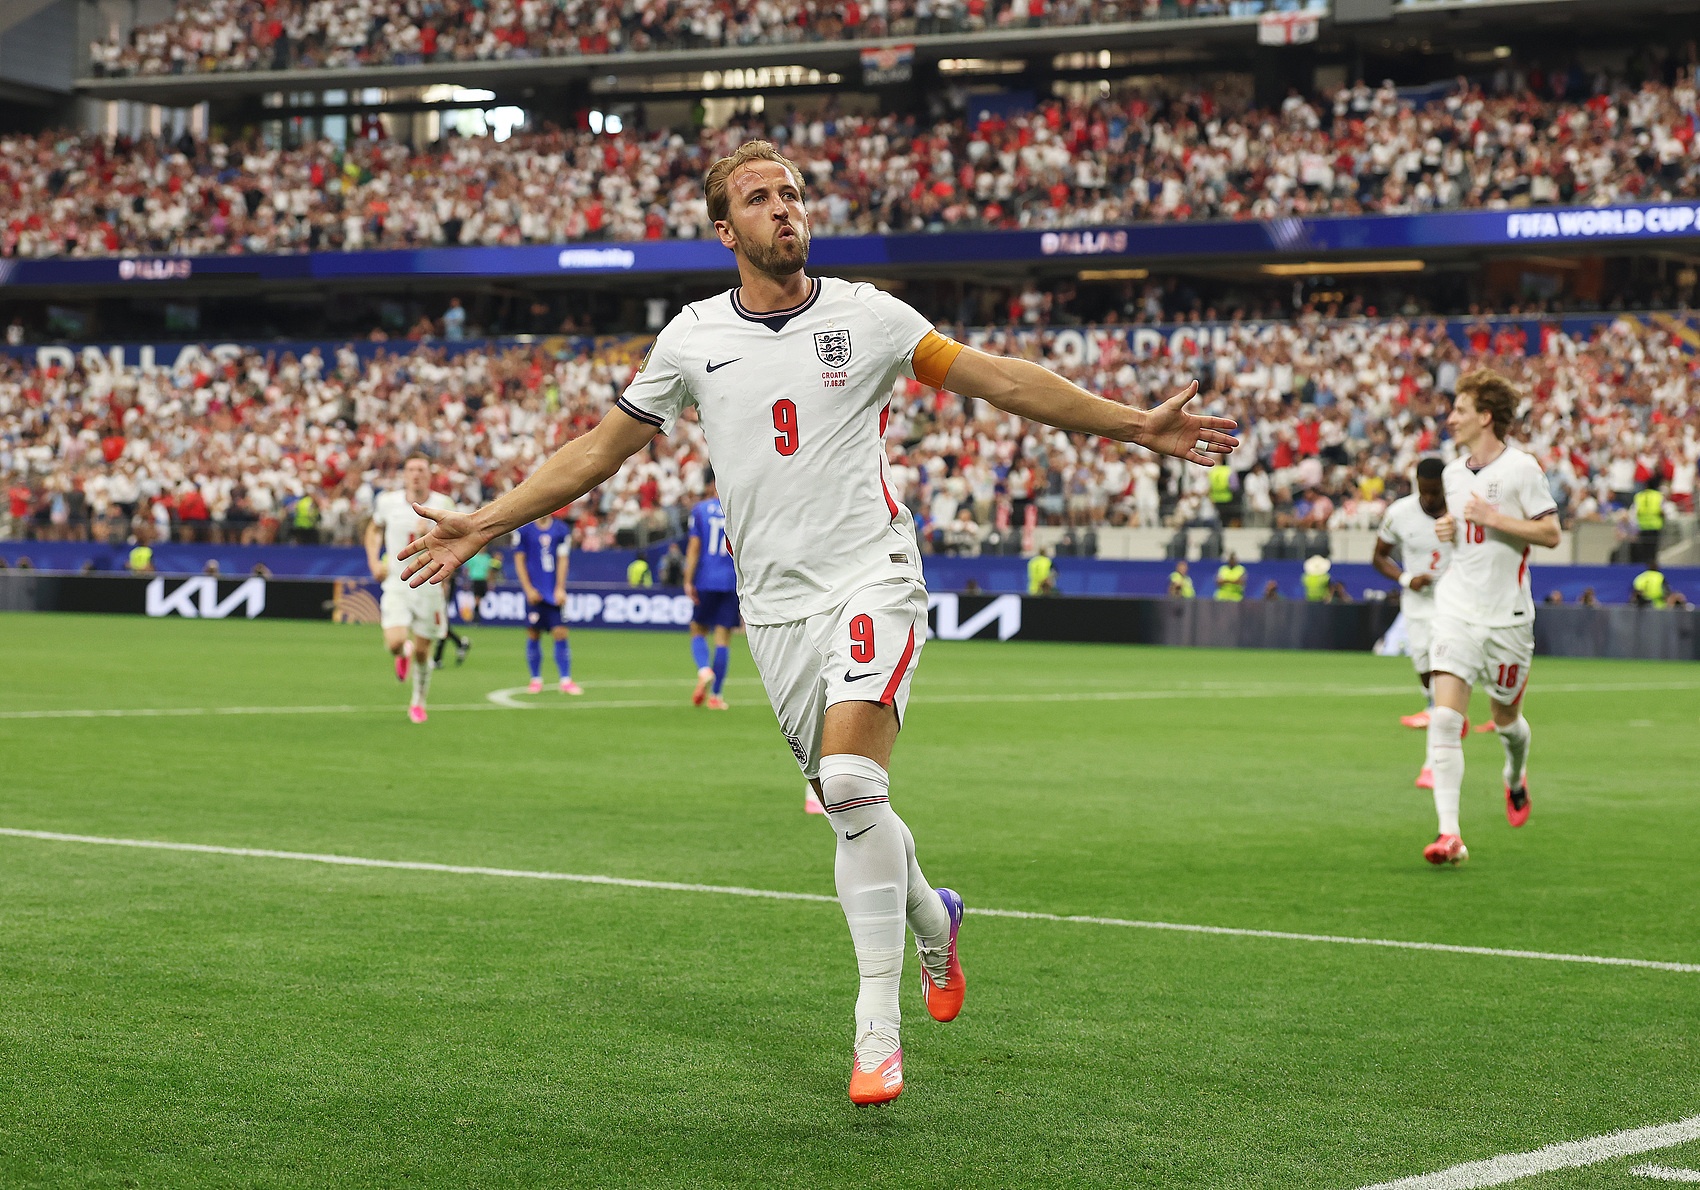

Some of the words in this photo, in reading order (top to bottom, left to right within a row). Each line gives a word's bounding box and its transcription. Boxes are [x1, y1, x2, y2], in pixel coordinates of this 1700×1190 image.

[1507, 213, 1559, 238] FIFA
[1557, 209, 1645, 236] WORLD
[1644, 206, 1695, 233] CUP
[821, 371, 848, 379] CROATIA
[771, 398, 800, 456] 9
[1429, 550, 1441, 570] 2
[145, 576, 267, 620] KIA
[561, 592, 603, 622] UP
[602, 593, 694, 625] 2026
[849, 613, 875, 663] 9
[1497, 663, 1519, 688] 18
